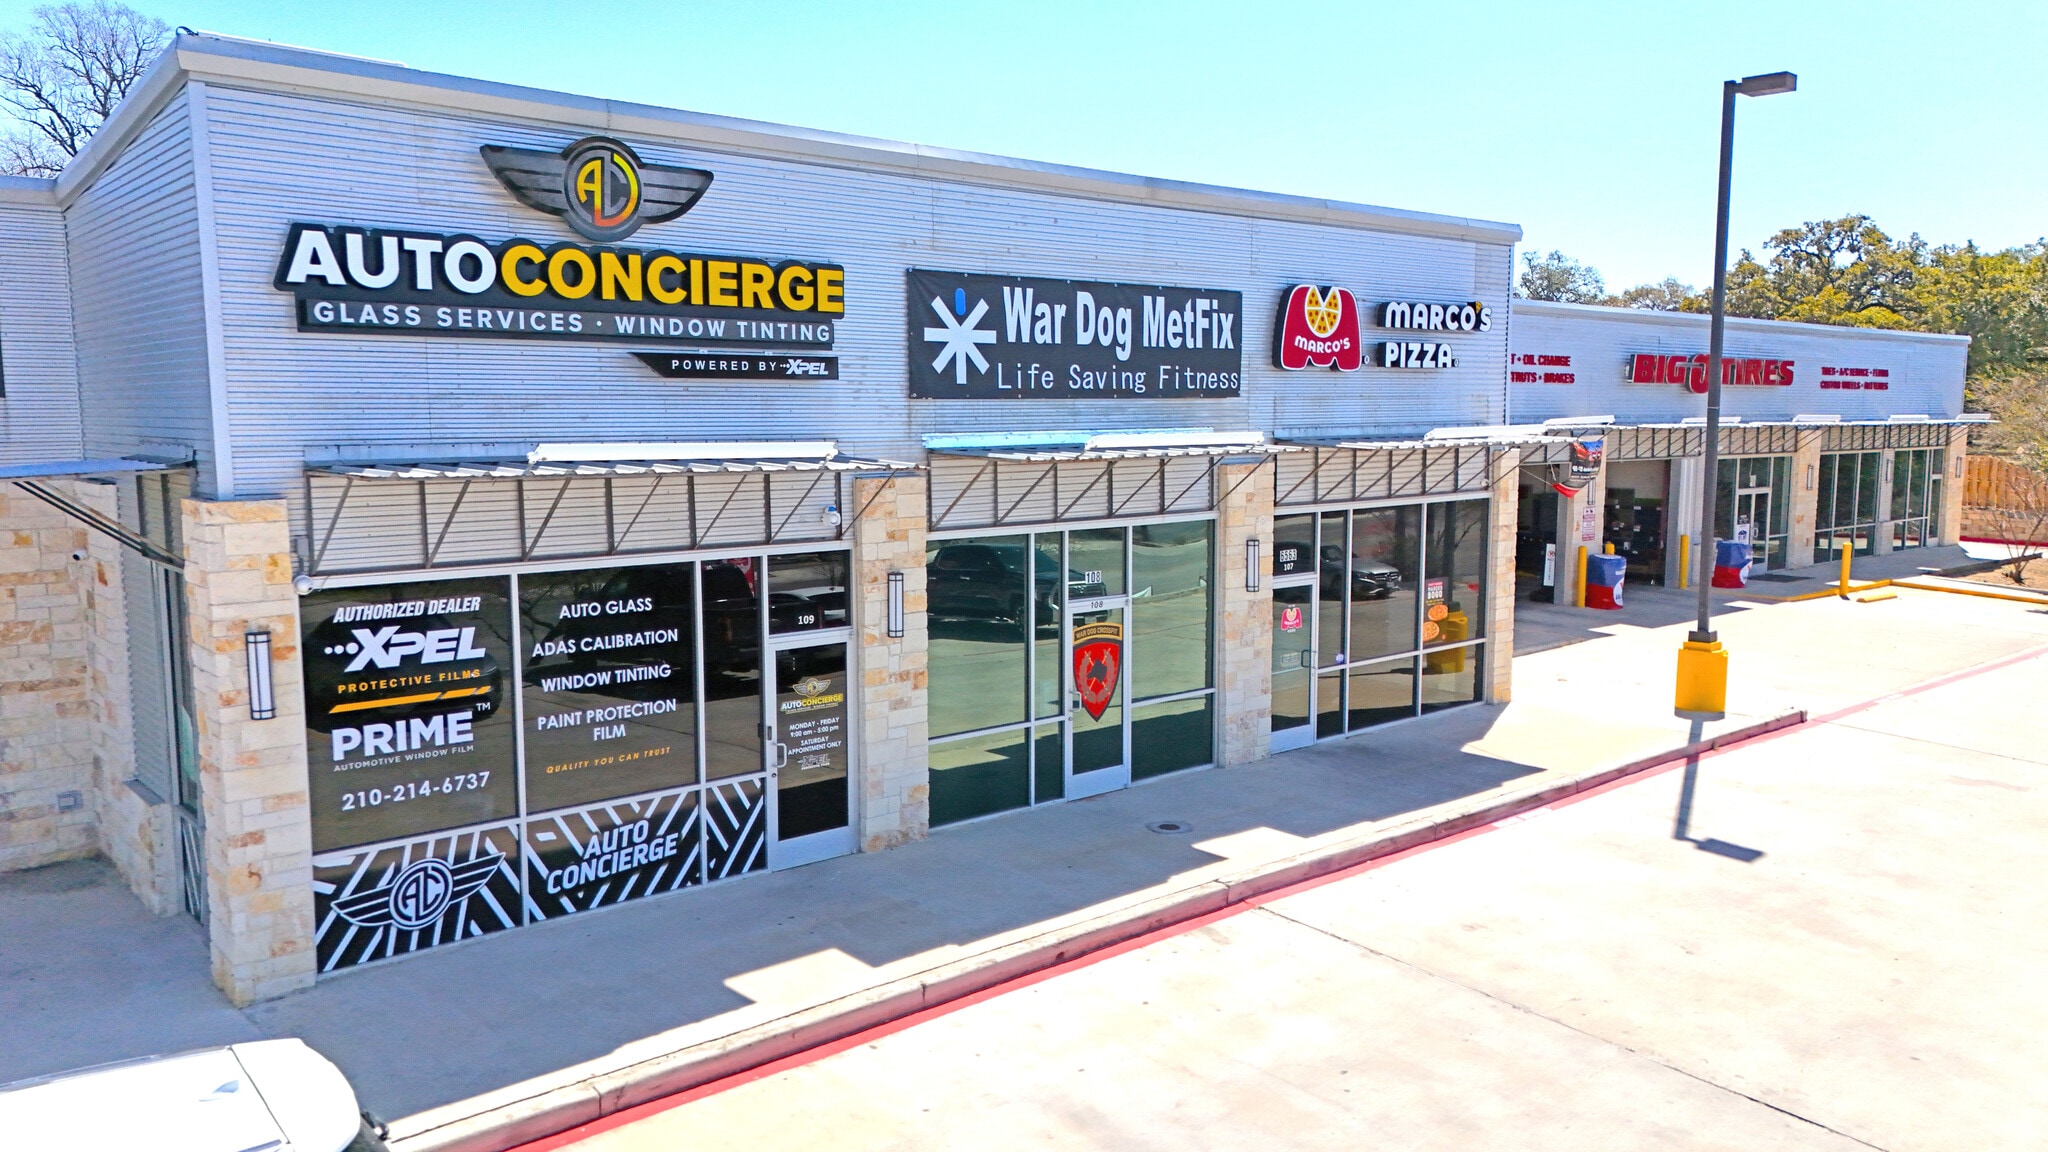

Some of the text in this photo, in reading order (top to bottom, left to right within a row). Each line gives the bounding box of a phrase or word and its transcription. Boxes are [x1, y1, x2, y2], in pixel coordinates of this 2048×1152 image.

[314, 301, 830, 342] GLASS SERVICES WINDOW TINTING
[1003, 286, 1235, 361] War Dog MetFix
[1384, 300, 1493, 332] MARCO'S
[1294, 335, 1351, 354] MARCO'S
[1384, 342, 1452, 368] PIZZA
[672, 358, 830, 377] POWERED BY XPEL
[1523, 354, 1537, 365] OIL
[1633, 354, 1687, 384] BIG
[1721, 358, 1795, 386] TIRES
[997, 362, 1239, 393] Life Saving Fitness
[1086, 571, 1101, 583] 108
[1284, 563, 1294, 571] 107
[333, 597, 481, 623] AUTHORIZED DEALER
[559, 598, 652, 619] AUTO GLASS
[1091, 600, 1104, 609] 108
[797, 615, 815, 625] 109
[344, 625, 486, 673] XPEL
[532, 629, 678, 657] ADAS CALIBRATION
[337, 669, 481, 694] PROTECTIVE FILMS
[542, 664, 672, 693] WINDOW TINTING
[476, 702, 491, 711] TM
[537, 699, 677, 730] PAINT PROTECTION
[331, 710, 474, 762] PRIME
[593, 724, 626, 741] FILM
[789, 721, 815, 731] MONDAY
[820, 717, 839, 726] FRIDAY
[788, 740, 842, 756] APPOINTMENT ONLY
[800, 736, 829, 746] SATURDAY
[333, 745, 474, 773] AUTOMOTIVE WINDOW FILM
[546, 746, 671, 774] QUALITY YOU CAN TRUST
[342, 771, 490, 811] 210-214-6737
[584, 820, 650, 858] AUTO
[547, 833, 679, 894] CONCIERGE
